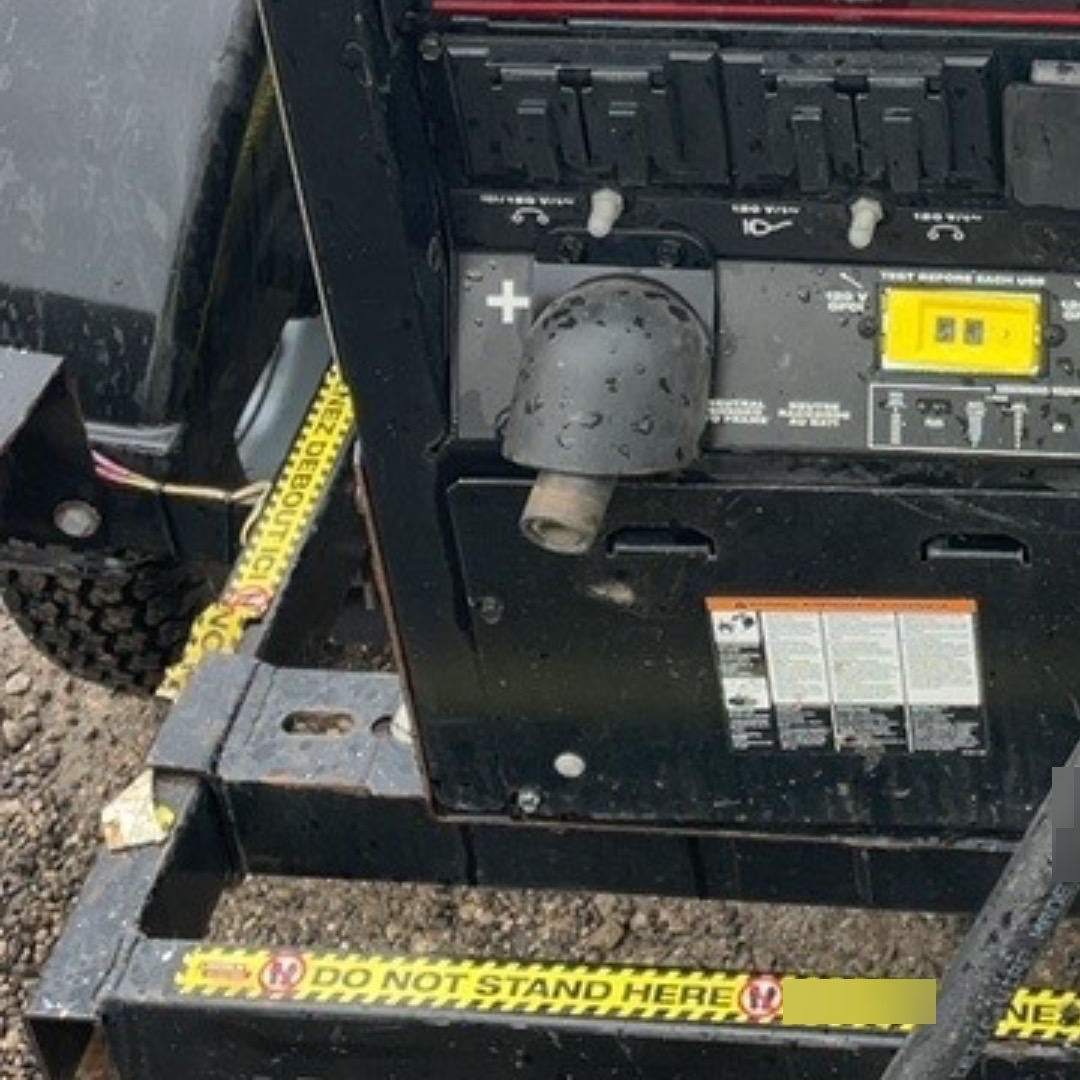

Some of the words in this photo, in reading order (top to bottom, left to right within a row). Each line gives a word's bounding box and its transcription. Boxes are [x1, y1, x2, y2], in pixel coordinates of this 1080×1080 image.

[881, 271, 914, 281] TEST
[918, 272, 973, 283] BEFORE
[976, 274, 1014, 284] EACH
[1016, 276, 1045, 286] USE
[268, 440, 327, 542] DEBOUT
[308, 966, 373, 992] DO
[381, 970, 465, 995] NOT
[475, 974, 615, 1002] STAND
[623, 982, 731, 1008] HERE
